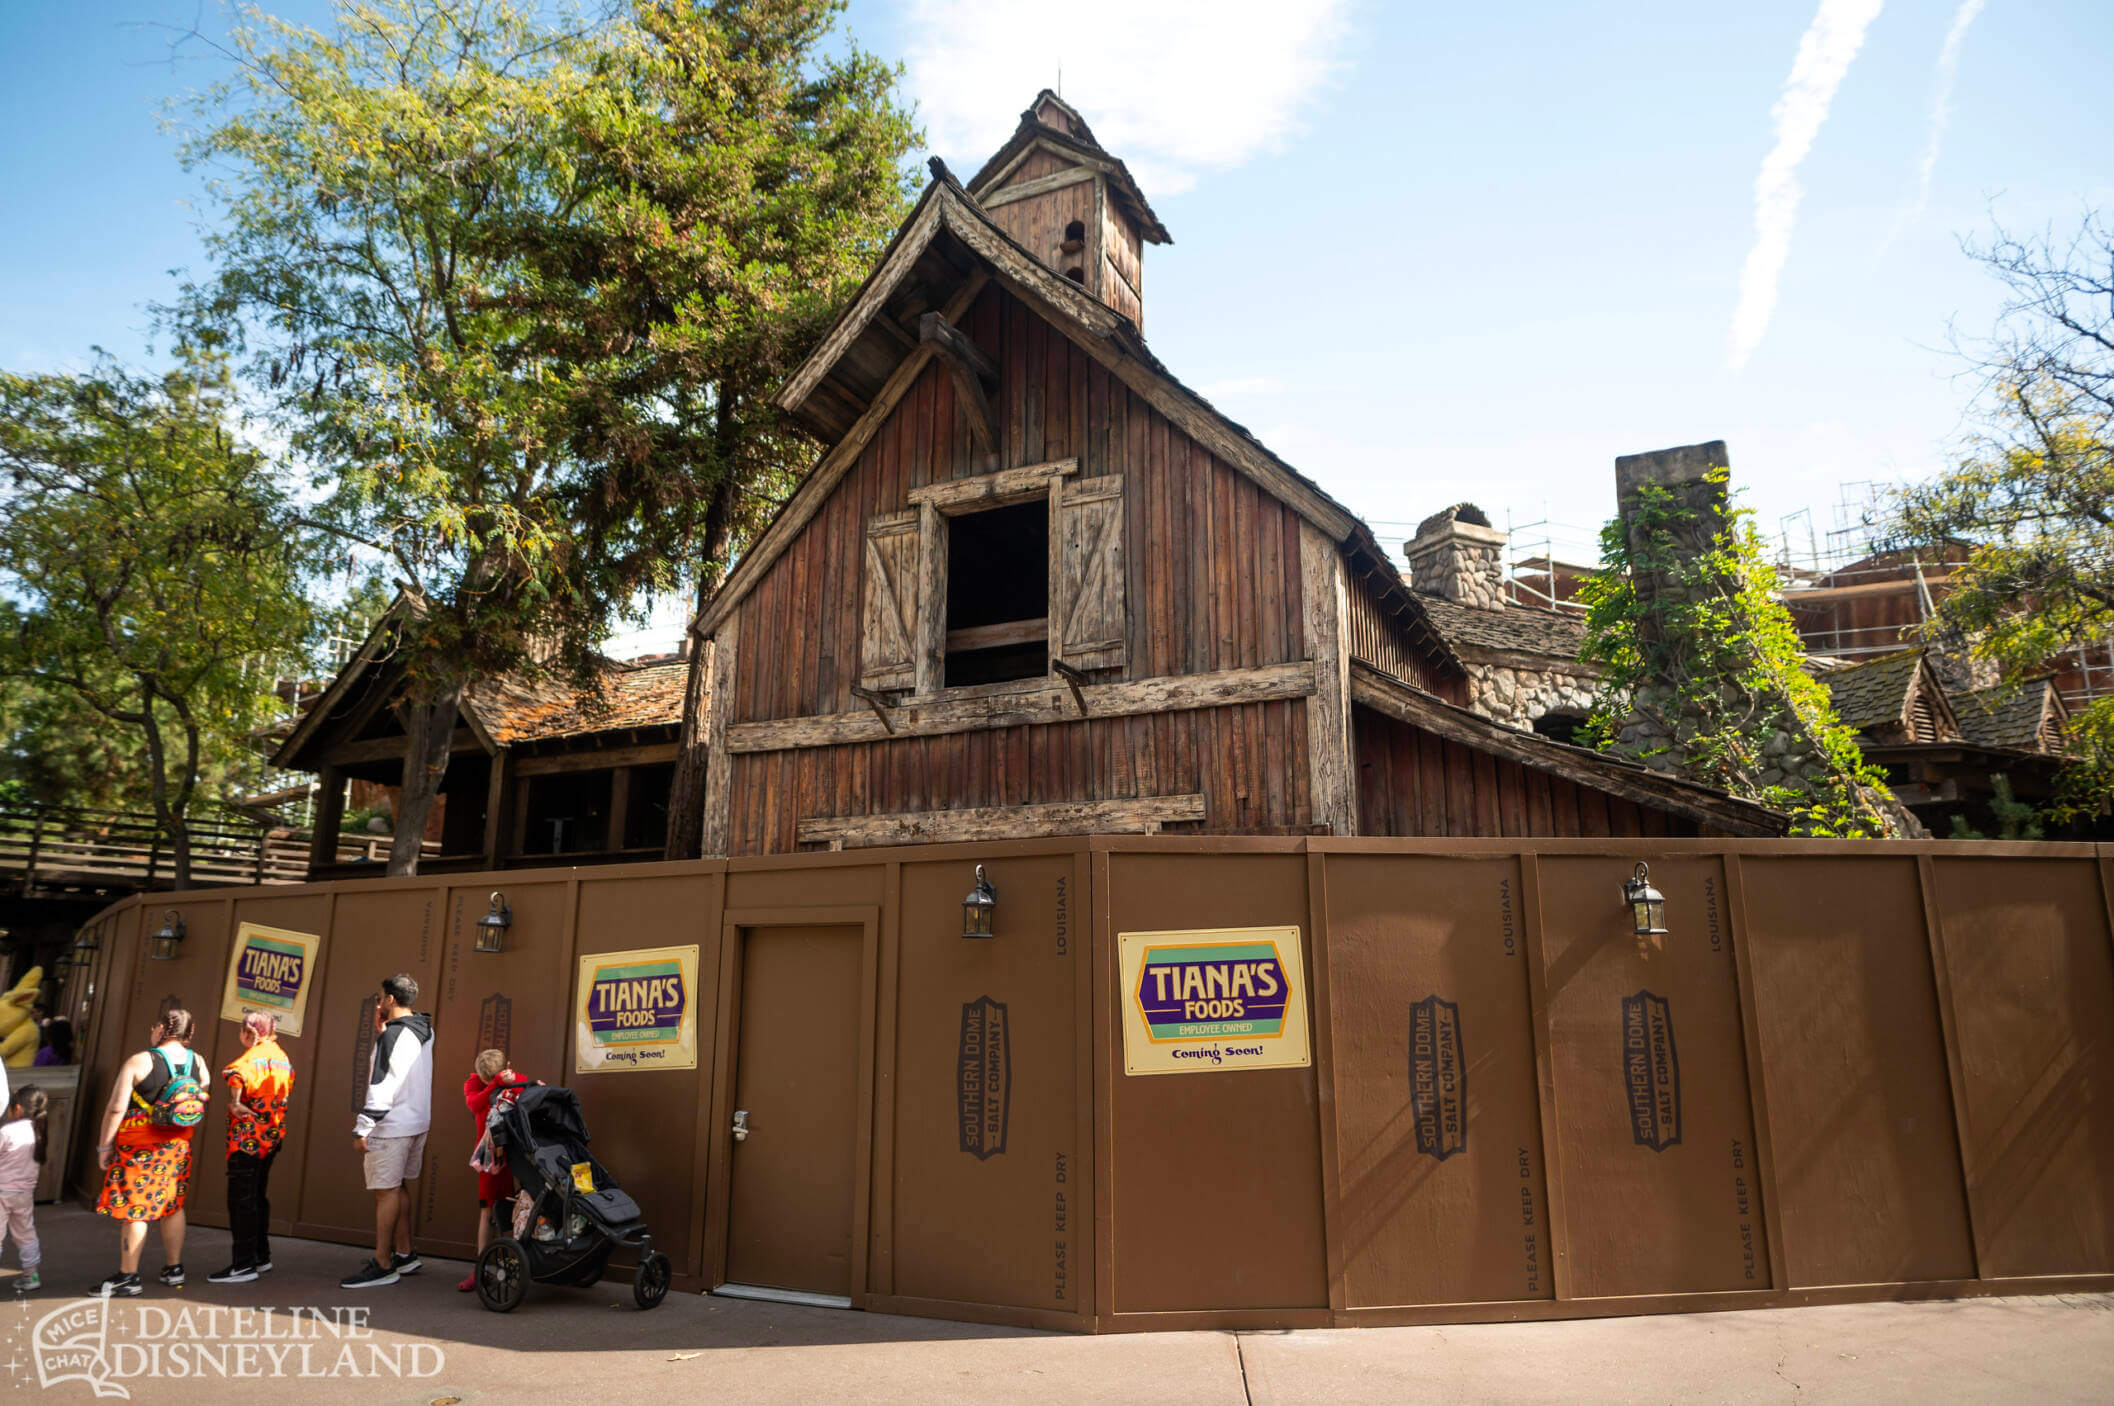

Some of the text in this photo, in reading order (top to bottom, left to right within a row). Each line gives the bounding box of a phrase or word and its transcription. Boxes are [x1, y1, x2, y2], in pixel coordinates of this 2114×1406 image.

[1056, 875, 1067, 957] LOUISIANA
[1500, 878, 1515, 957] LOUISIANA
[1704, 876, 1721, 952] LOUISIANA
[244, 948, 301, 983] TIANA'S
[254, 976, 282, 993] FOODS
[596, 978, 680, 1012] TIANA'S
[1149, 962, 1279, 1002] TIANA'S
[616, 1009, 655, 1028] FOODS
[1179, 1022, 1253, 1035] EMPLOYEE OWNED
[1184, 999, 1245, 1020] FOODS
[606, 1047, 665, 1066] Coming Soon!
[963, 1007, 981, 1147] SOUTHERN DOME
[987, 1020, 1001, 1134] SALT COMPANY
[1172, 1043, 1264, 1065] Coming Soon!
[1415, 1007, 1437, 1147] SOUTHERN DOME
[1440, 1020, 1458, 1134] SALT COMPANY
[1628, 1002, 1653, 1139] SOUTHERN DOME
[1651, 1014, 1673, 1125] SALT COMPANY
[1056, 1151, 1067, 1300] PLEASE KEEP DRY
[1517, 1147, 1539, 1292] PLEASE KEEP DRY
[1731, 1138, 1755, 1280] PLEASE KEEP DRY
